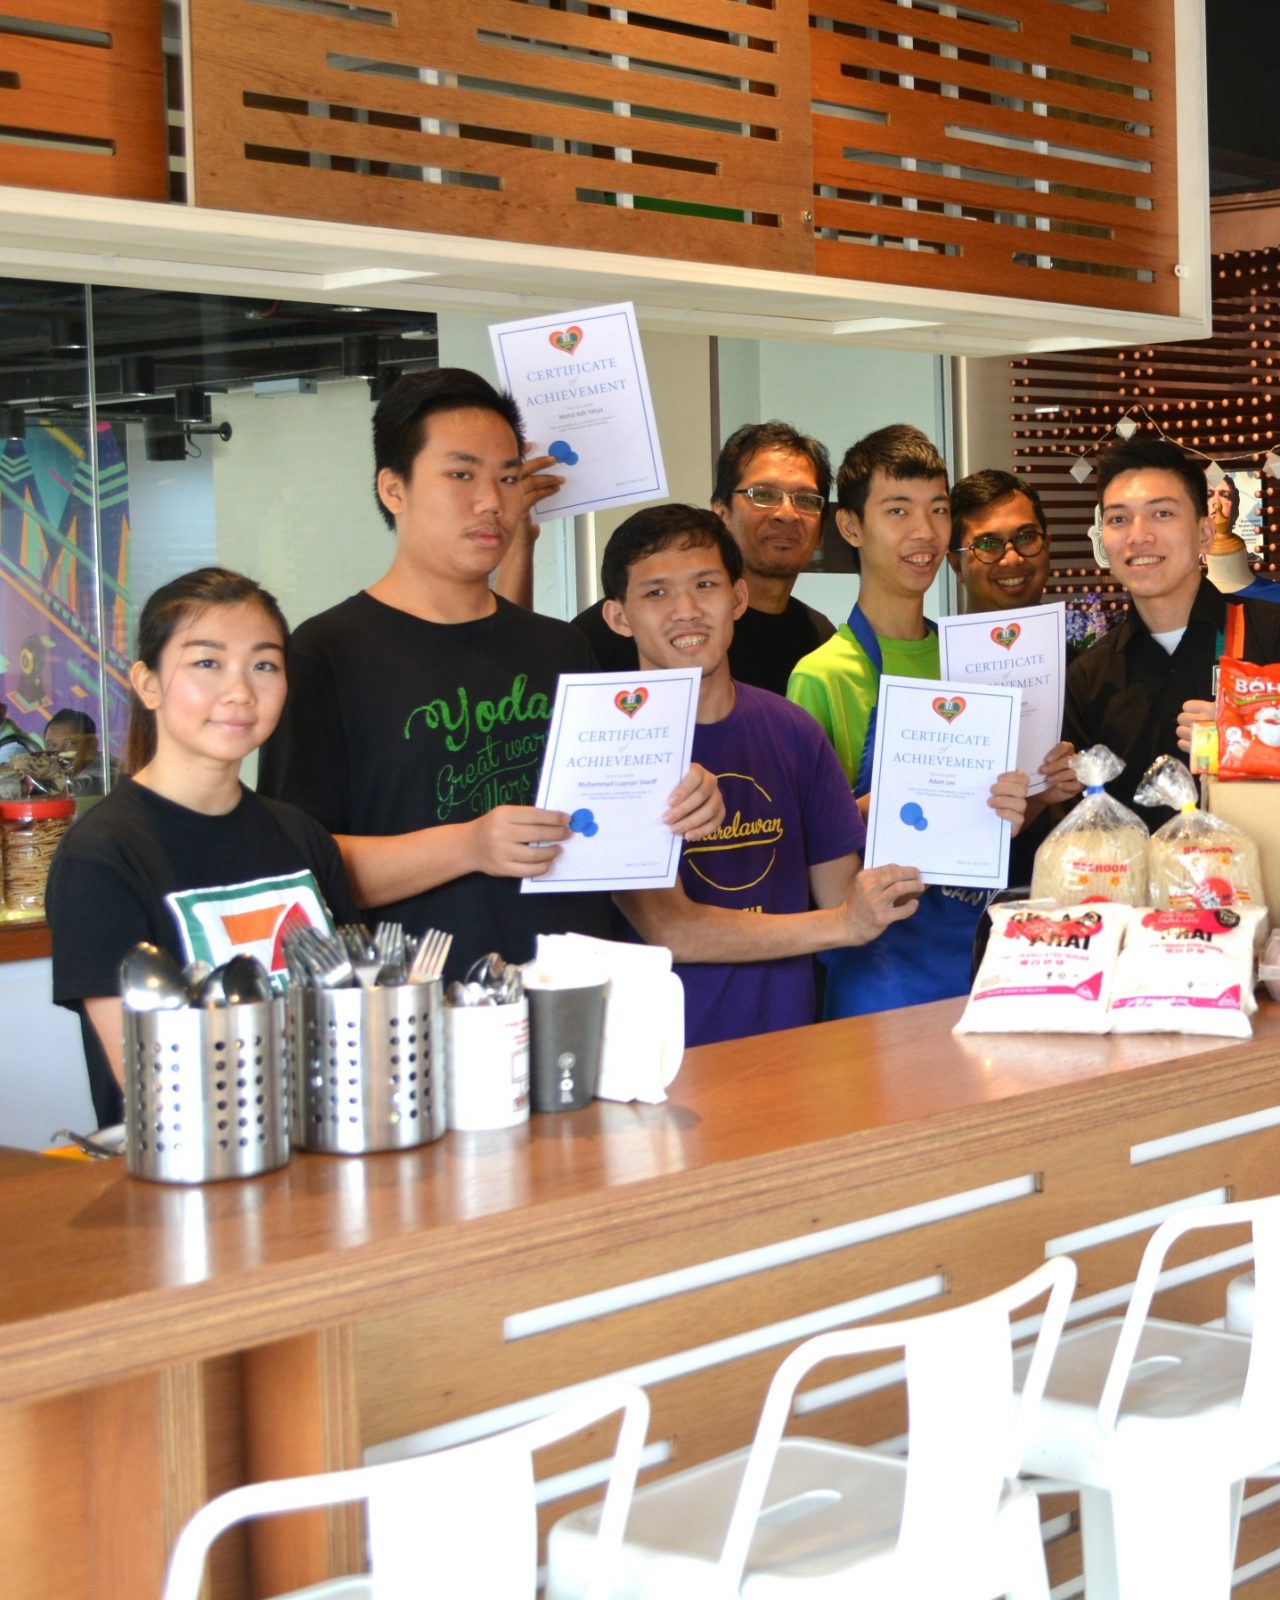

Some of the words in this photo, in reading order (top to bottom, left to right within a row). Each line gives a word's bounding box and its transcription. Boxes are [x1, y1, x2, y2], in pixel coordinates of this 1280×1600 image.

[527, 357, 617, 382] CERTIFICATE
[526, 379, 627, 407] ACHIEVEMENT
[965, 654, 1045, 674] CERTIFICATE
[405, 673, 554, 751] Yoda
[578, 727, 670, 743] CERTIFICATE
[901, 728, 990, 747] CERTIFICATE
[566, 752, 673, 768] ACHIEVEMENT
[892, 752, 995, 770] ACHIEVEMENT
